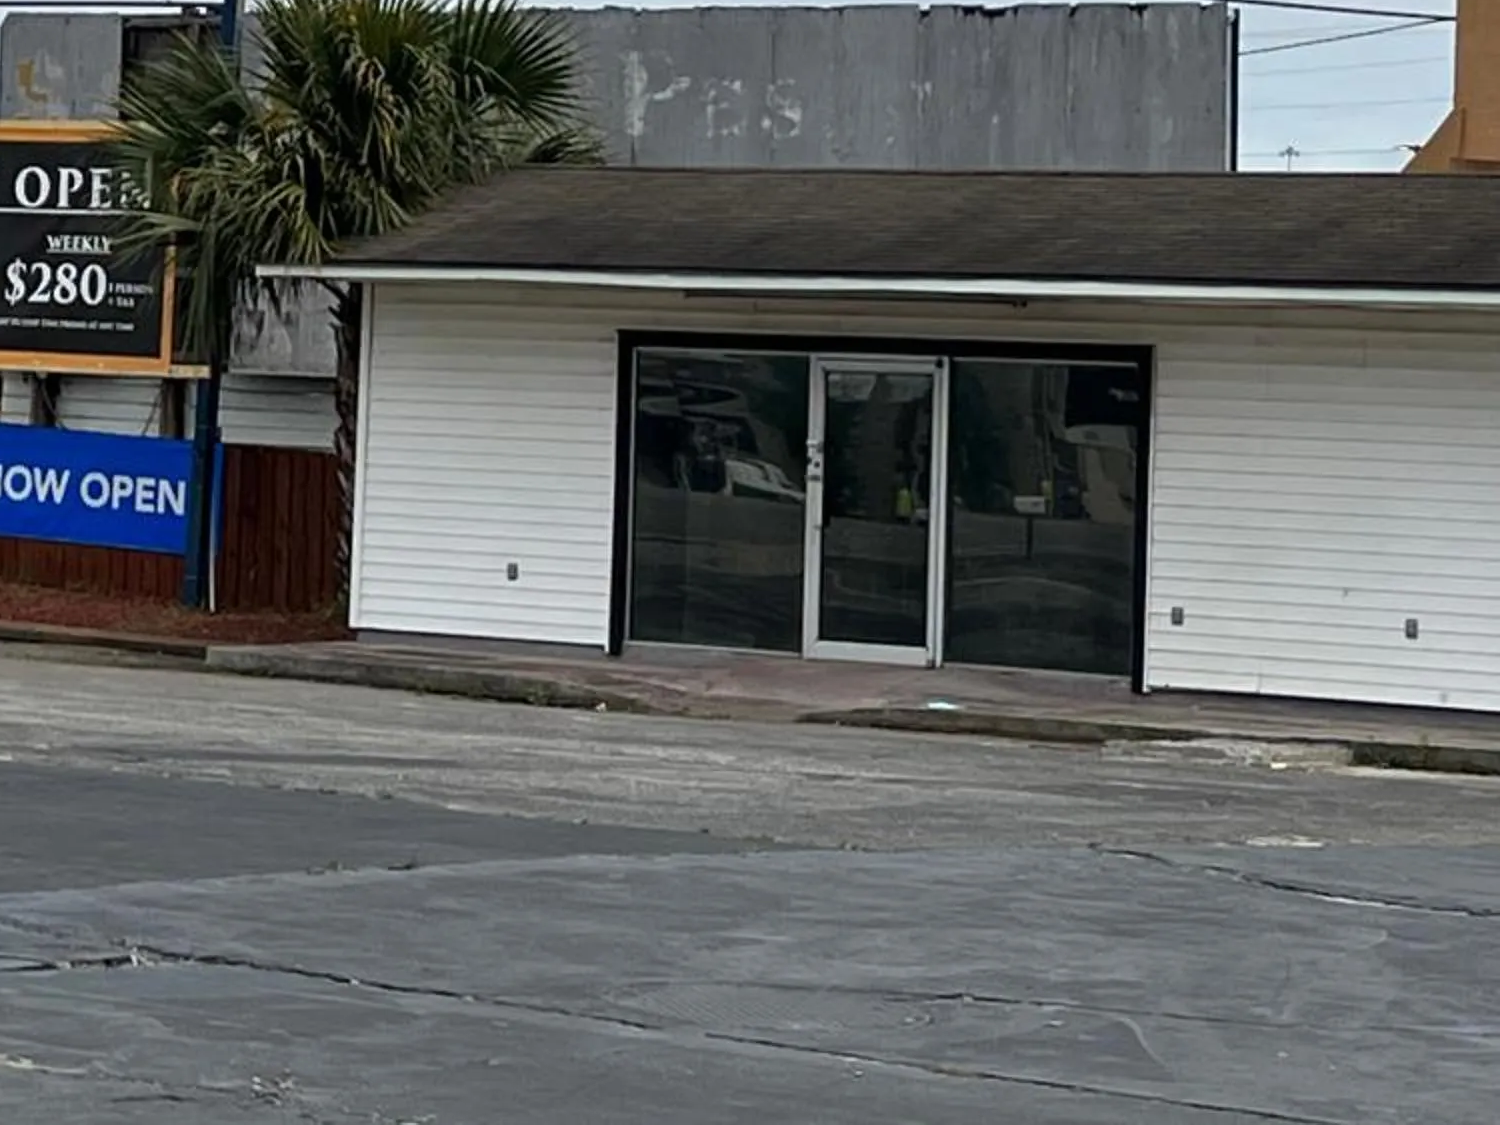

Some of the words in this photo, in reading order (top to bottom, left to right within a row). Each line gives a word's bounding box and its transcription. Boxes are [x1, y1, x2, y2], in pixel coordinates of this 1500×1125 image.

[46, 234, 113, 253] WEEKLY
[4, 257, 107, 306] $280
[80, 472, 186, 516] OPEN
